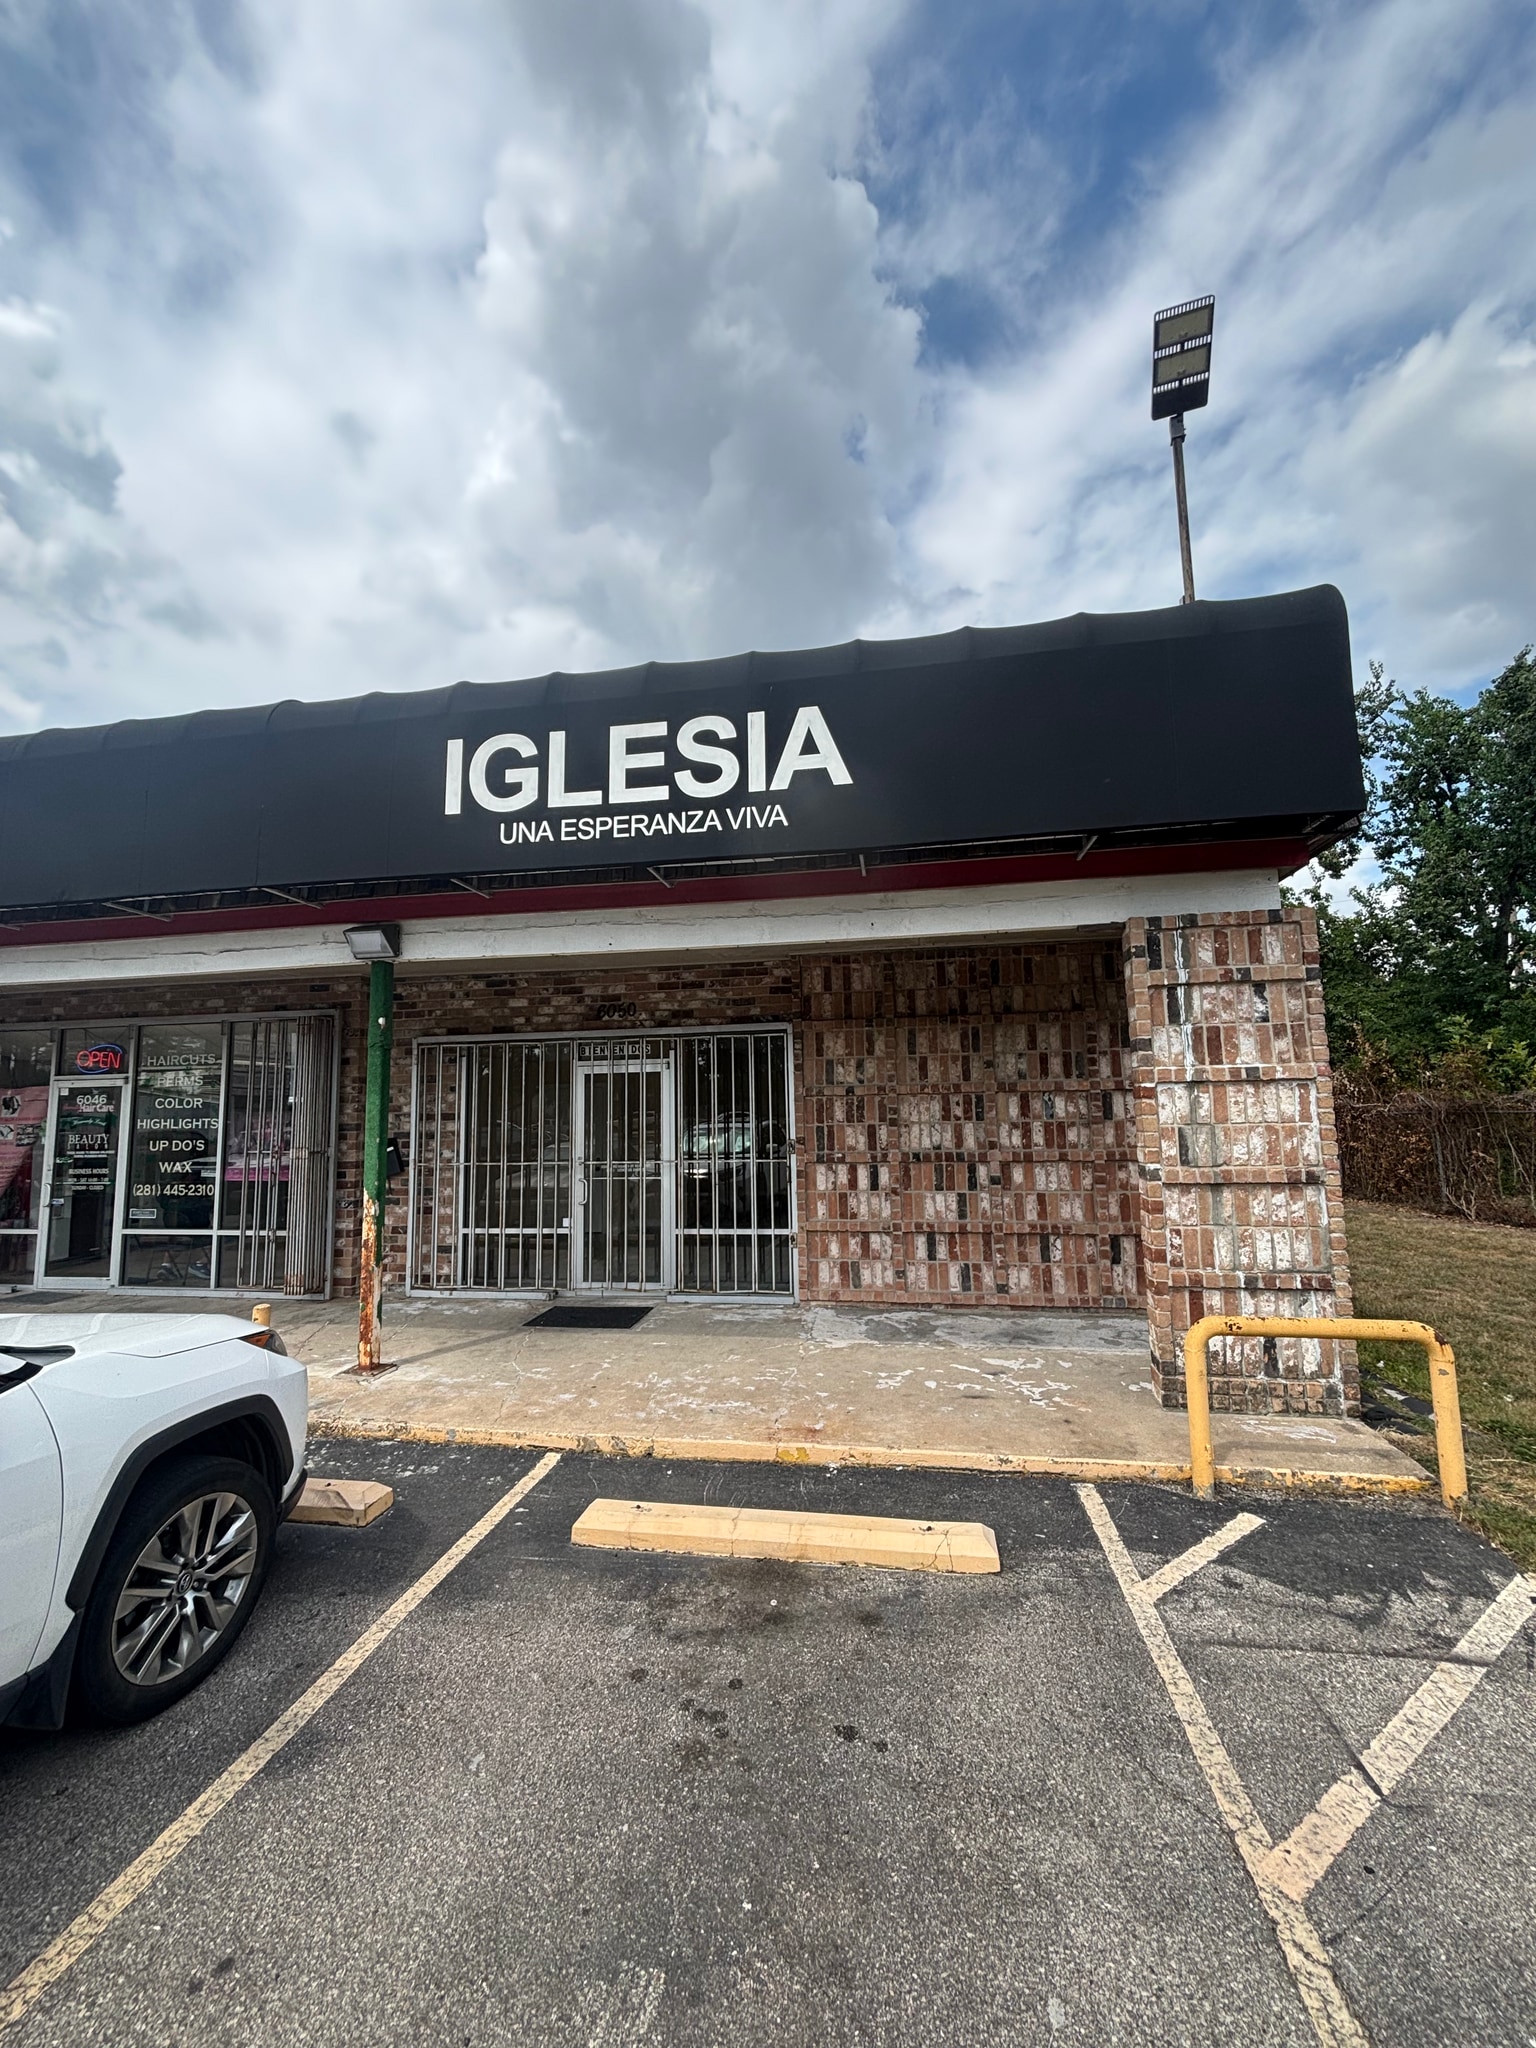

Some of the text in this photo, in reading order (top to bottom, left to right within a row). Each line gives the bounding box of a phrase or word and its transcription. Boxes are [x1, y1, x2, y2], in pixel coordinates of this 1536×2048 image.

[444, 705, 854, 815] IGLESIA
[499, 804, 788, 845] UNA ESPERANZA VIVA
[77, 1050, 121, 1068] OPEN
[147, 1053, 216, 1066] HAIRCUTS
[157, 1076, 204, 1087] PERMS
[76, 1095, 107, 1104] 6046
[154, 1098, 203, 1109] COLOR
[137, 1118, 219, 1129] HIGHLIGHTS
[68, 1134, 109, 1144] BEAUTY
[149, 1139, 205, 1151] UP DO'S
[159, 1161, 193, 1173] WAX
[133, 1184, 215, 1197] (281) 445-2310
